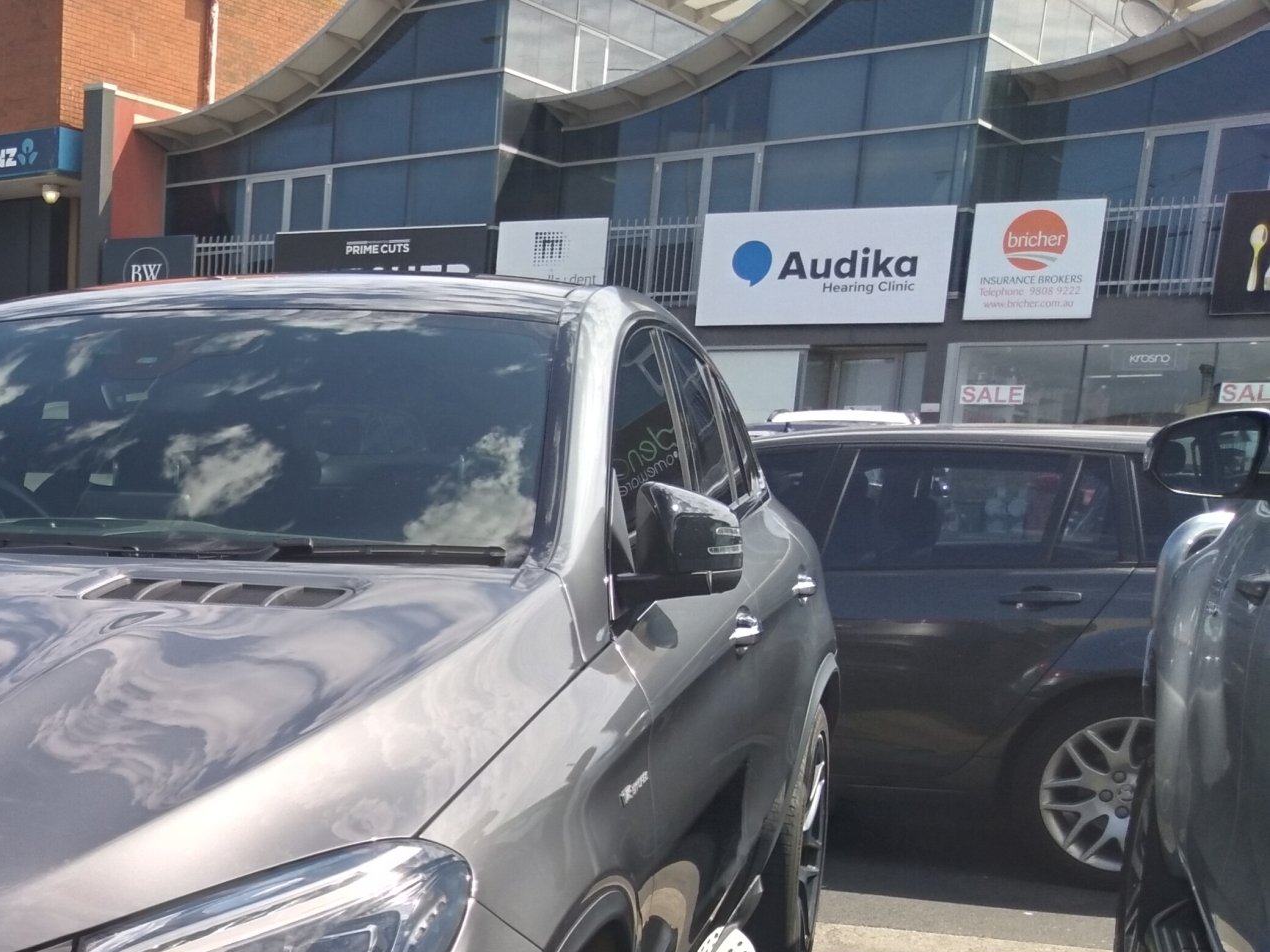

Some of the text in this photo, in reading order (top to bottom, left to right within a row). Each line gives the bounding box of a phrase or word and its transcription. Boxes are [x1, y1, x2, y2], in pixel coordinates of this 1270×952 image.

[1007, 231, 1066, 248] bricher
[345, 243, 410, 255] PRIME CUTS
[777, 247, 919, 280] Audika
[979, 275, 1083, 285] INSURANCE BROKERS
[822, 281, 915, 294] Hearing Clinic
[979, 287, 1025, 298] Telephone
[1056, 286, 1081, 295] 9222
[983, 299, 1074, 308] www.bricher.com.au
[962, 385, 1023, 403] SALE
